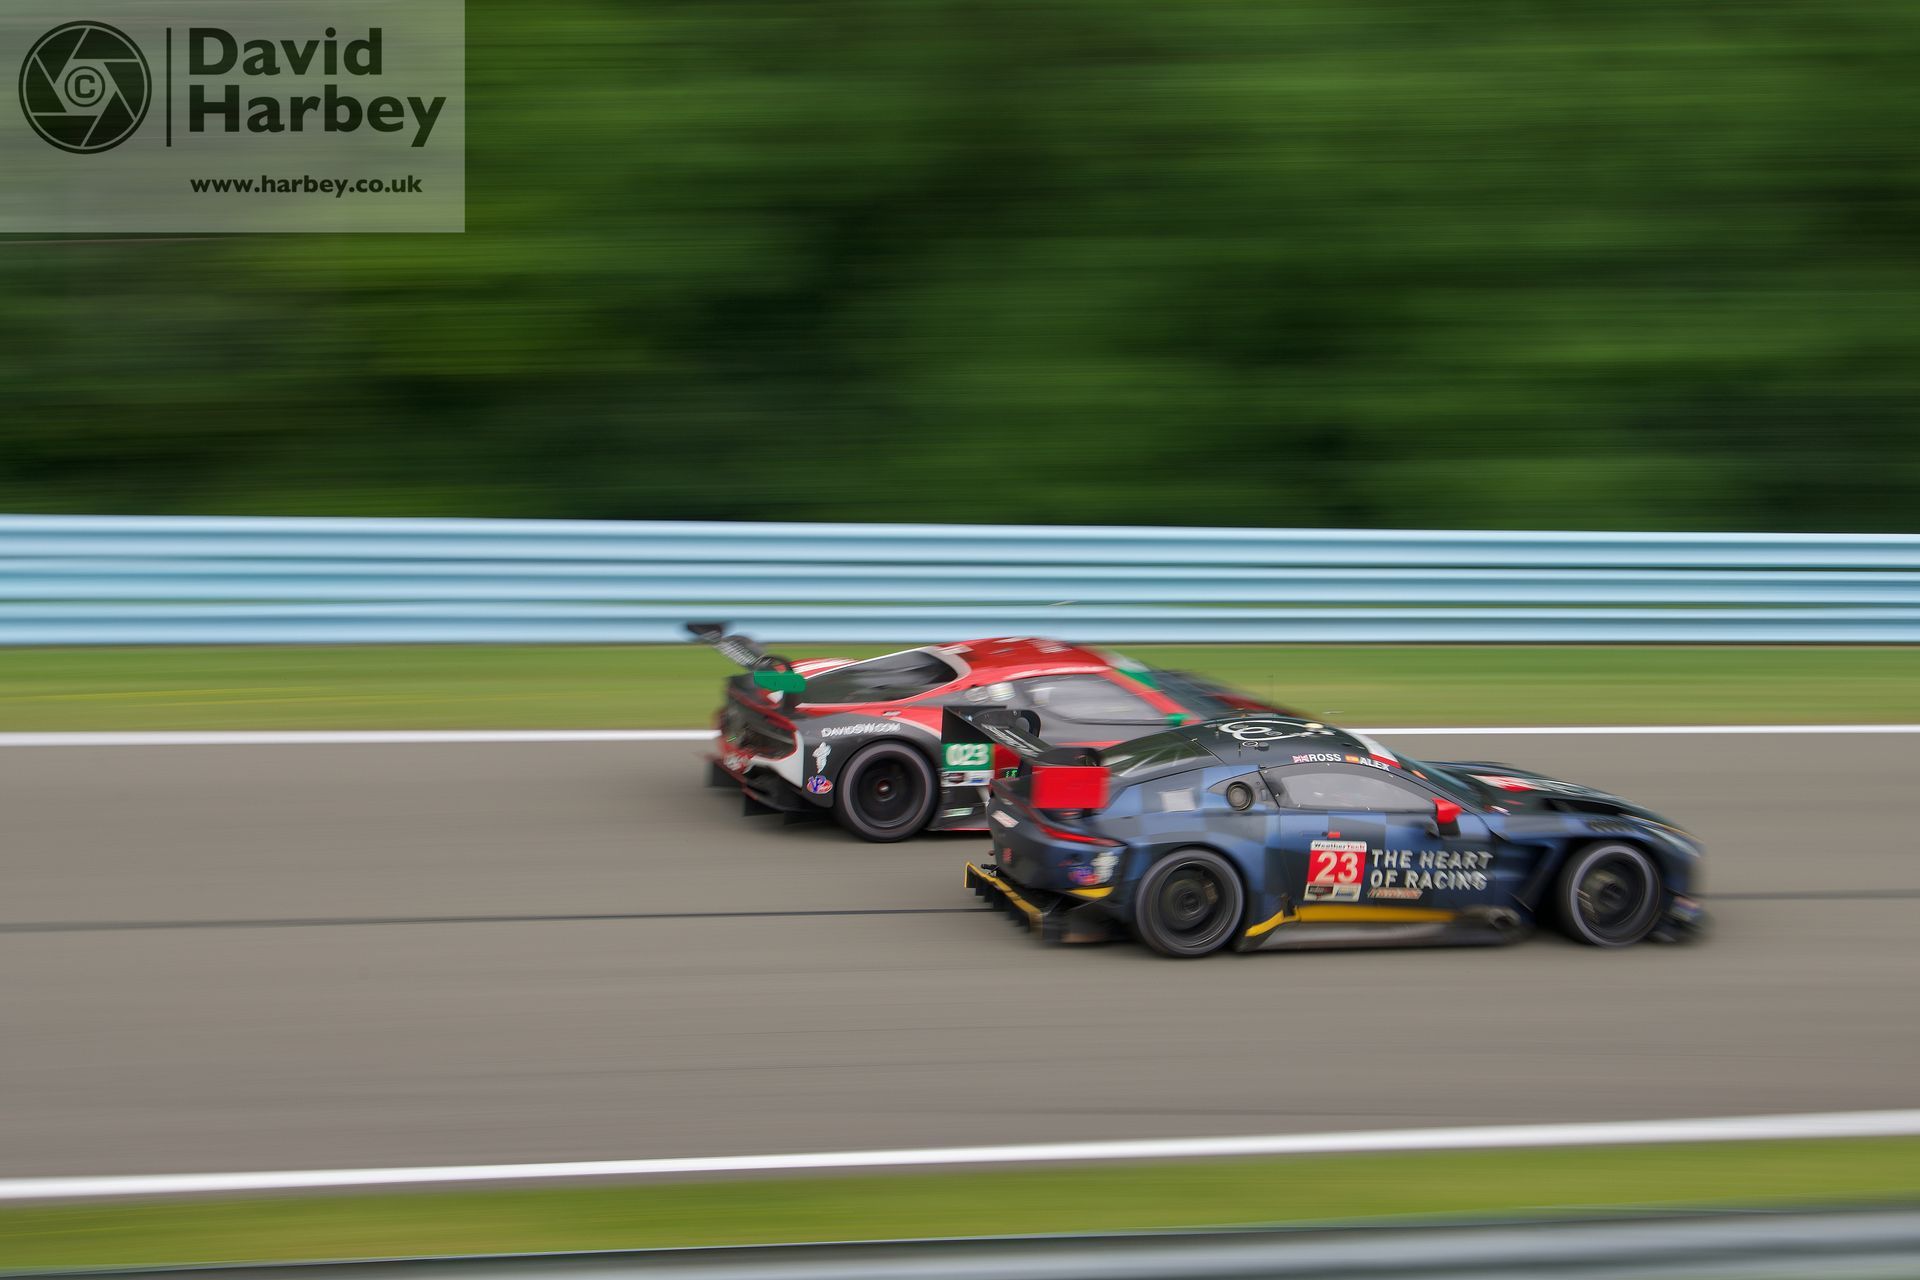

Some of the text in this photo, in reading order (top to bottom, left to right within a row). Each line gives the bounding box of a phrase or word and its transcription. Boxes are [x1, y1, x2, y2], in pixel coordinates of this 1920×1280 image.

[946, 743, 990, 767] 023
[1308, 753, 1390, 772] ROSS ALEX
[1313, 851, 1359, 884] 23
[1371, 849, 1494, 870] THE HEART
[1370, 869, 1488, 891] OF RACING
